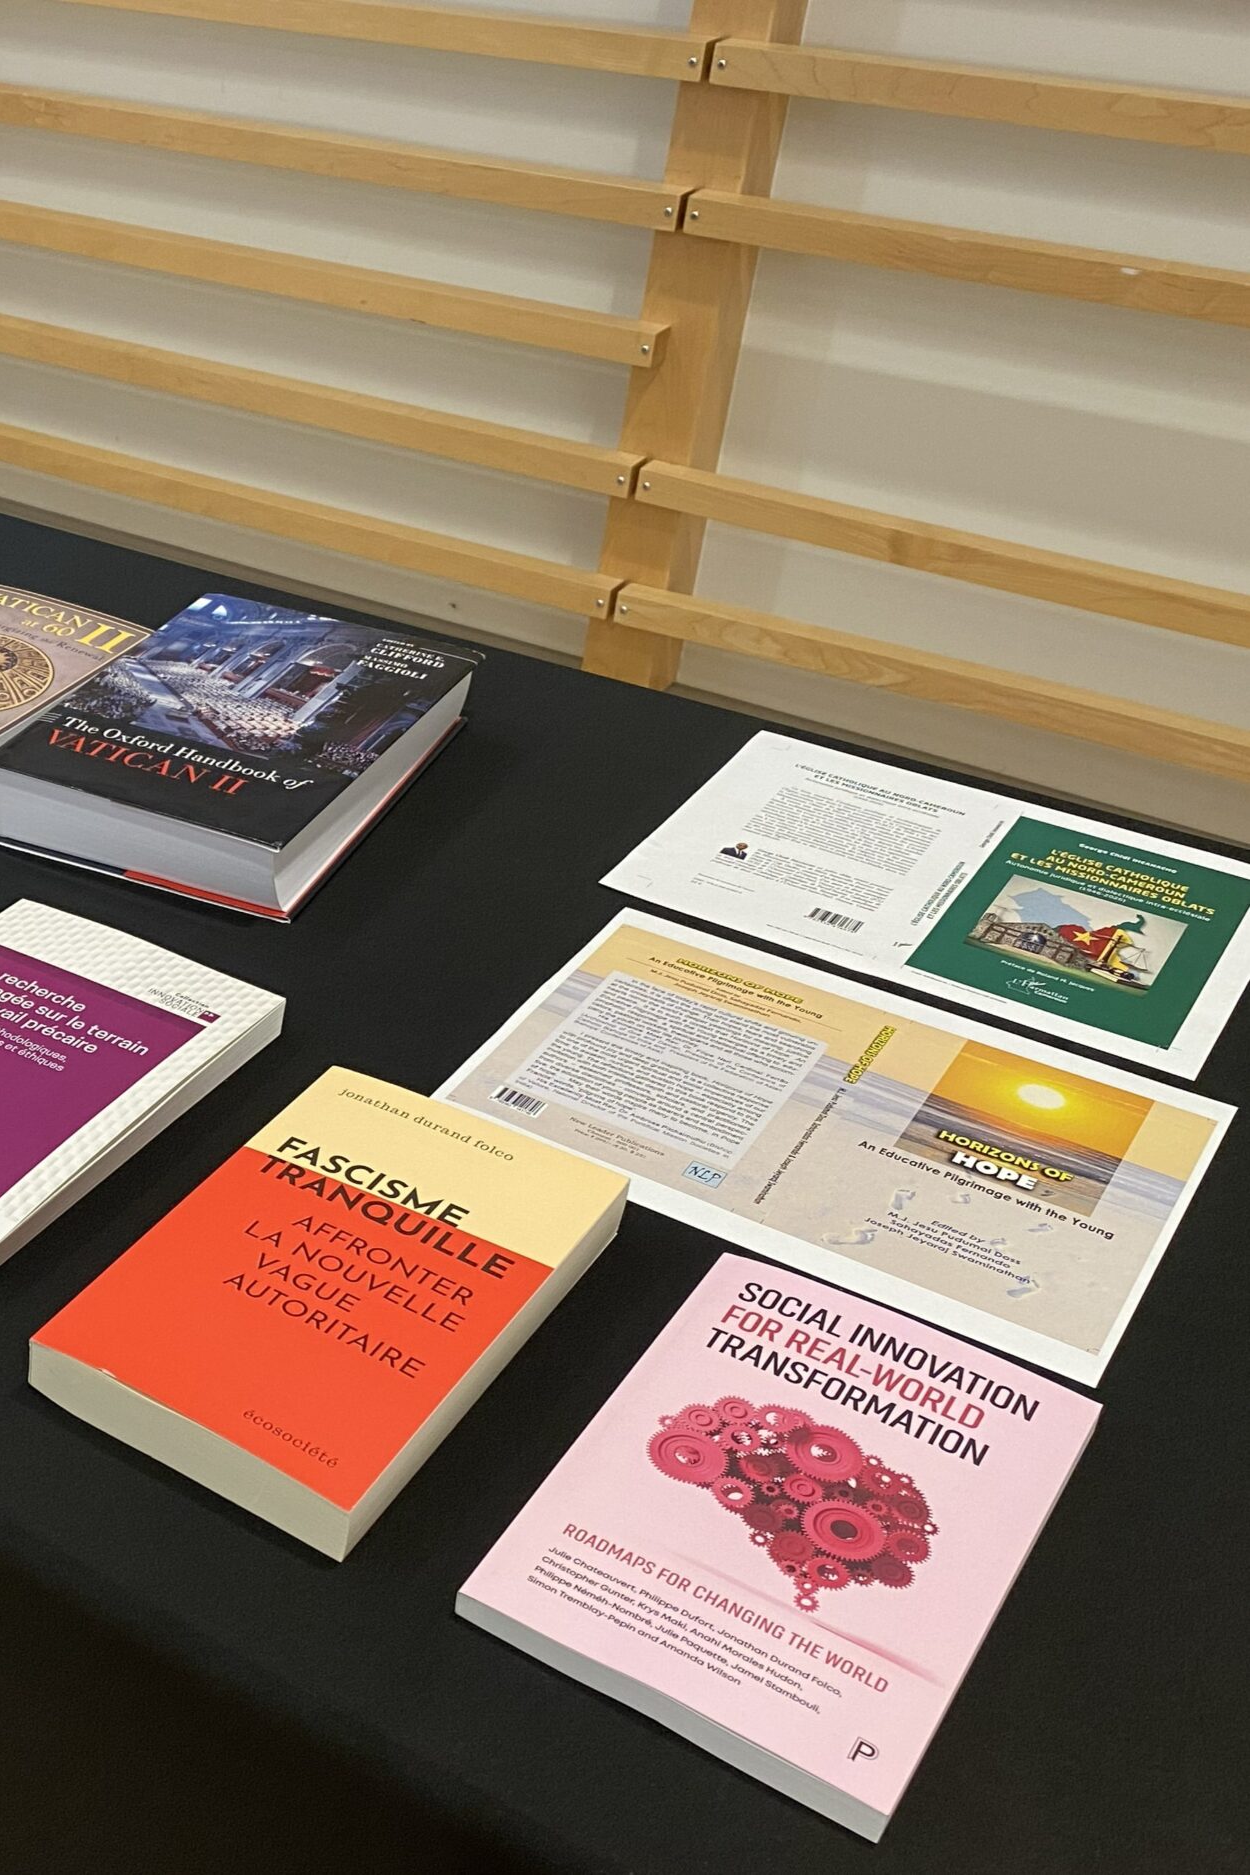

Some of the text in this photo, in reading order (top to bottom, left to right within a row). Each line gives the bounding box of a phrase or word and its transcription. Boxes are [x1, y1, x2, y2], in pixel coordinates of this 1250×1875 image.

[20, 618, 76, 637] at 60
[75, 622, 136, 654] II
[370, 647, 445, 668] CLIFFORD
[376, 643, 436, 659] CATHERINE
[356, 660, 428, 680] FAGGIOLI
[363, 655, 408, 668] MASSIMO
[48, 728, 250, 795] VATICAN II
[63, 716, 314, 791] The Oxford Handbook of
[1010, 852, 1215, 915] ET LES MISSIONNAIRES OBLATS
[1046, 855, 1187, 899] AU NORD-CAMEROUN
[1050, 848, 1190, 893] L'ÉGLISE CATHOLIQUE
[4, 1043, 19, 1052] et
[17, 1048, 65, 1072] éthiques
[21, 1018, 98, 1054] précaire
[35, 1007, 67, 1022] sur
[66, 1016, 85, 1030] le
[87, 1025, 149, 1056] terrain
[337, 1088, 515, 1162] jonathan durand folco
[276, 1136, 471, 1228] FASCISME
[688, 1166, 722, 1183] NLP
[938, 1130, 1074, 1182] HORIZONS OF
[950, 1151, 1039, 1190] HOPE
[259, 1155, 515, 1279] TRANQUILLE
[858, 1140, 1115, 1240] An Educative Pilgrimage with the Young
[291, 1215, 476, 1306] AFFRONTER
[863, 1217, 1031, 1284] Joseph Jeyaraj Swaminathan
[911, 1220, 940, 1236] Jesu
[993, 1249, 1022, 1265] Doss
[930, 1220, 986, 1244] Edited by
[956, 1244, 1011, 1269] Fernando
[243, 1220, 467, 1332] LA NOUVELLE
[256, 1253, 362, 1313] VAGUE
[222, 1272, 426, 1379] AUTORITAIRE
[738, 1282, 1040, 1422] SOCIAL INNOVATION
[704, 1327, 990, 1466] TRANSFORMATION
[721, 1305, 985, 1429] FOR REAL-WORLD
[242, 1409, 340, 1469] écosociété
[527, 1575, 741, 1686] Simon Tremblay-Pepin and Amanda Wilson
[548, 1547, 842, 1698] Julie Chateauvert, Philippe Dufort, Jonathan Durand Folco,
[562, 1524, 889, 1693] ROADMAPS FOR CHANGING THE WORLD
[848, 1736, 879, 1761] P
